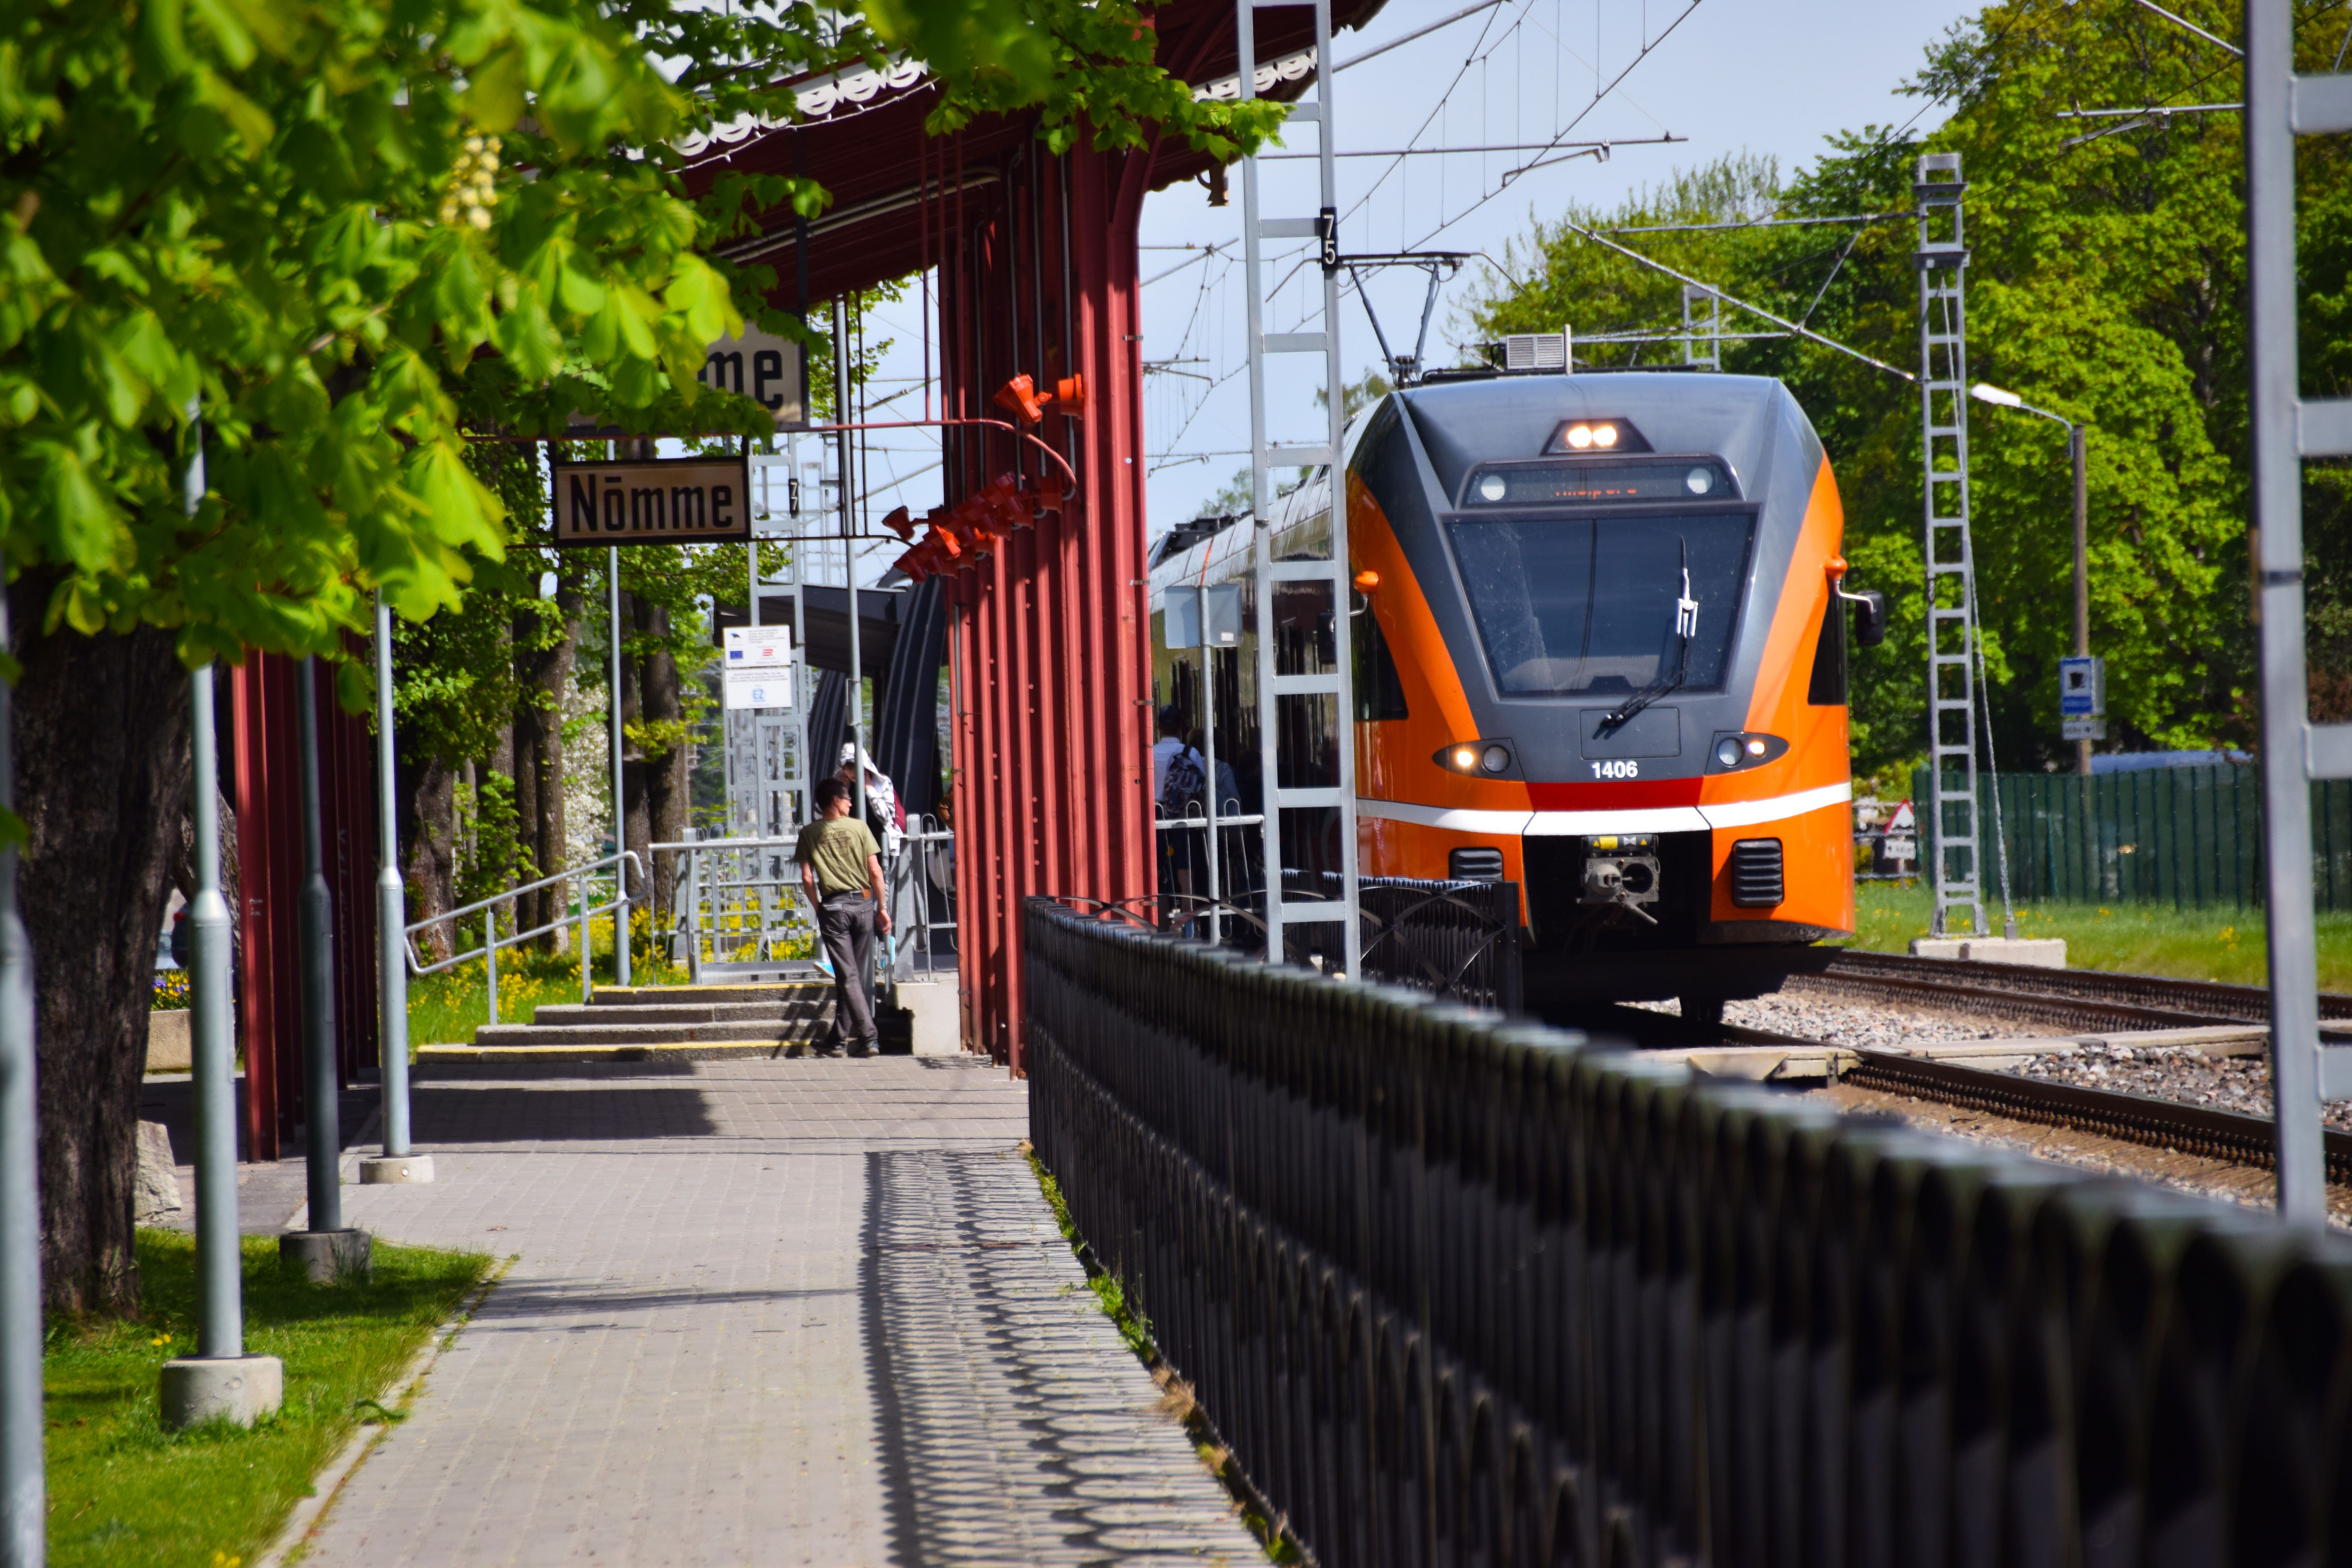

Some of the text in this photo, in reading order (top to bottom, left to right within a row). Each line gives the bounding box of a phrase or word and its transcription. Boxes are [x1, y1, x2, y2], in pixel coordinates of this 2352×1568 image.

[1323, 214, 1336, 265] 75
[790, 482, 798, 511] 77
[1591, 760, 1639, 779] 1406
